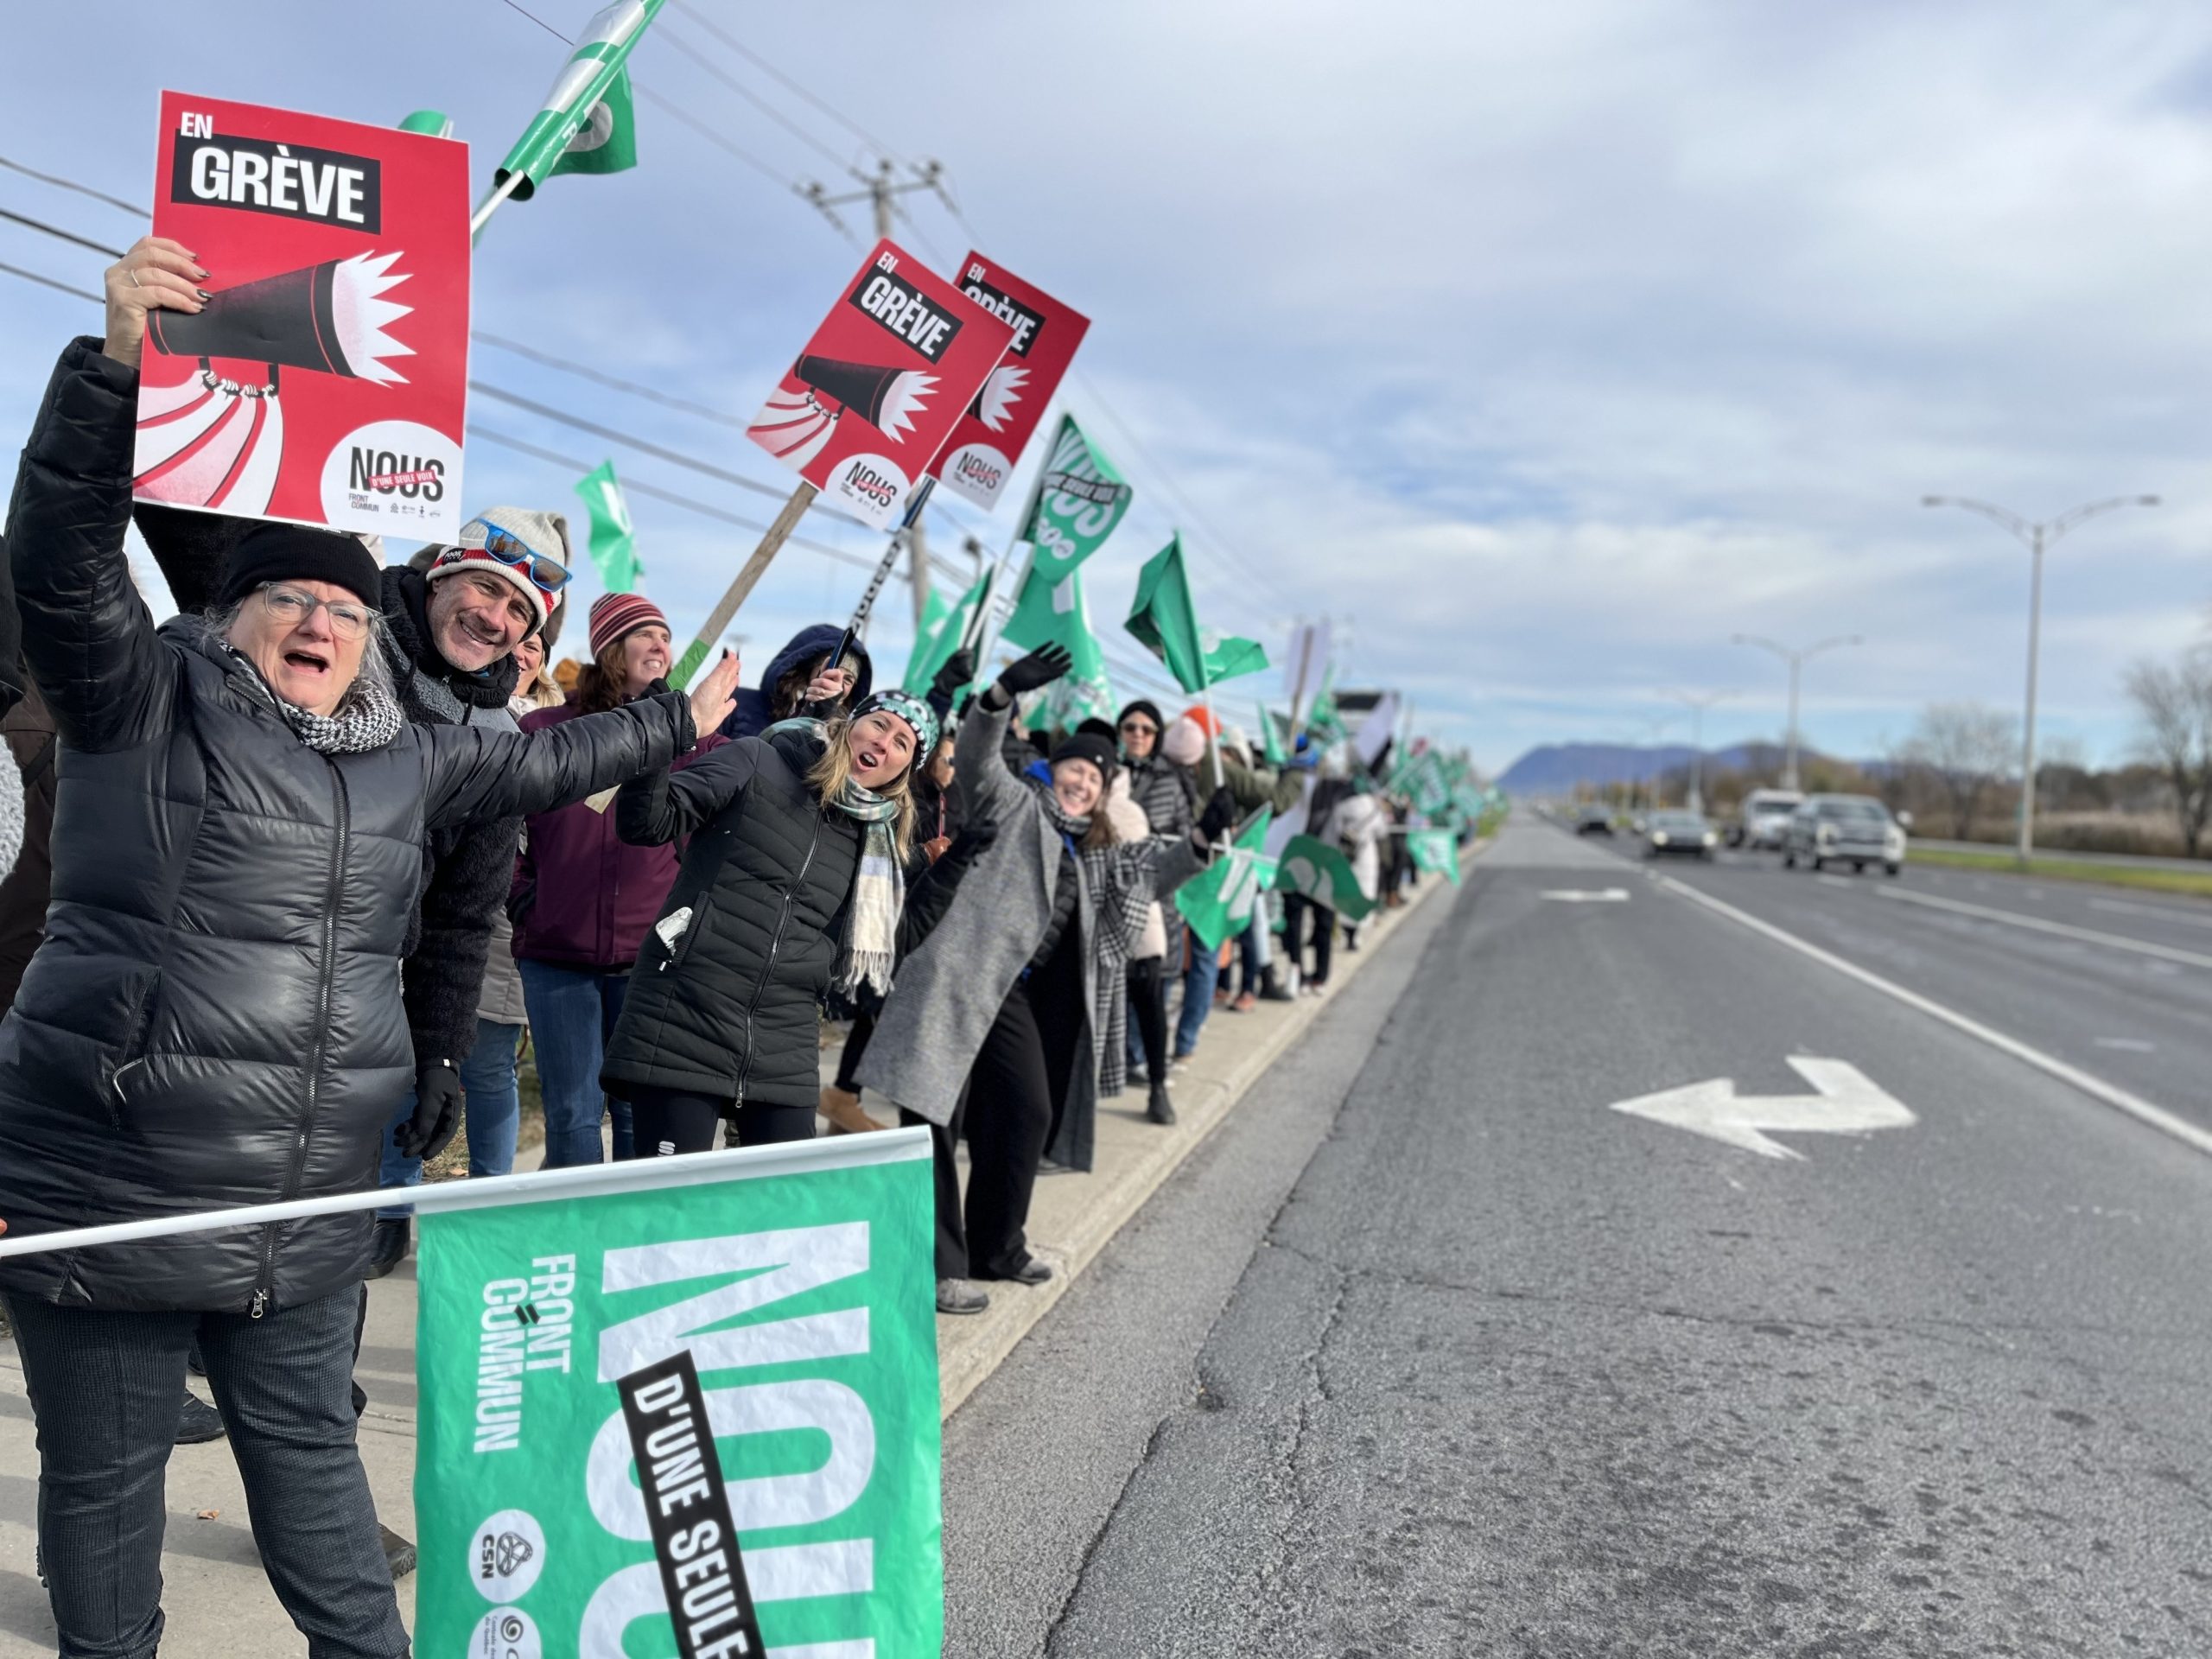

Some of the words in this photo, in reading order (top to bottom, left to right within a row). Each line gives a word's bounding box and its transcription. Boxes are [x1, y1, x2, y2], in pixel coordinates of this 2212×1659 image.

[181, 111, 213, 140] EN
[190, 144, 365, 224] GRÈVE
[876, 251, 899, 274] EN
[967, 262, 986, 283] EN
[861, 276, 950, 356] GRÈVE
[350, 446, 445, 503] NOUS
[372, 475, 393, 487] D'UNE
[395, 473, 416, 485] SEULE
[416, 471, 435, 481] VOIX
[845, 461, 898, 507] NOUS
[957, 451, 1001, 490] NOUS
[348, 493, 369, 503] FRONT
[351, 501, 379, 512] COMMUN
[526, 1253, 575, 1374] FRONT
[474, 1278, 529, 1453] COMMUN
[633, 1373, 711, 1516] D'UNE
[481, 1534, 495, 1580] CSN
